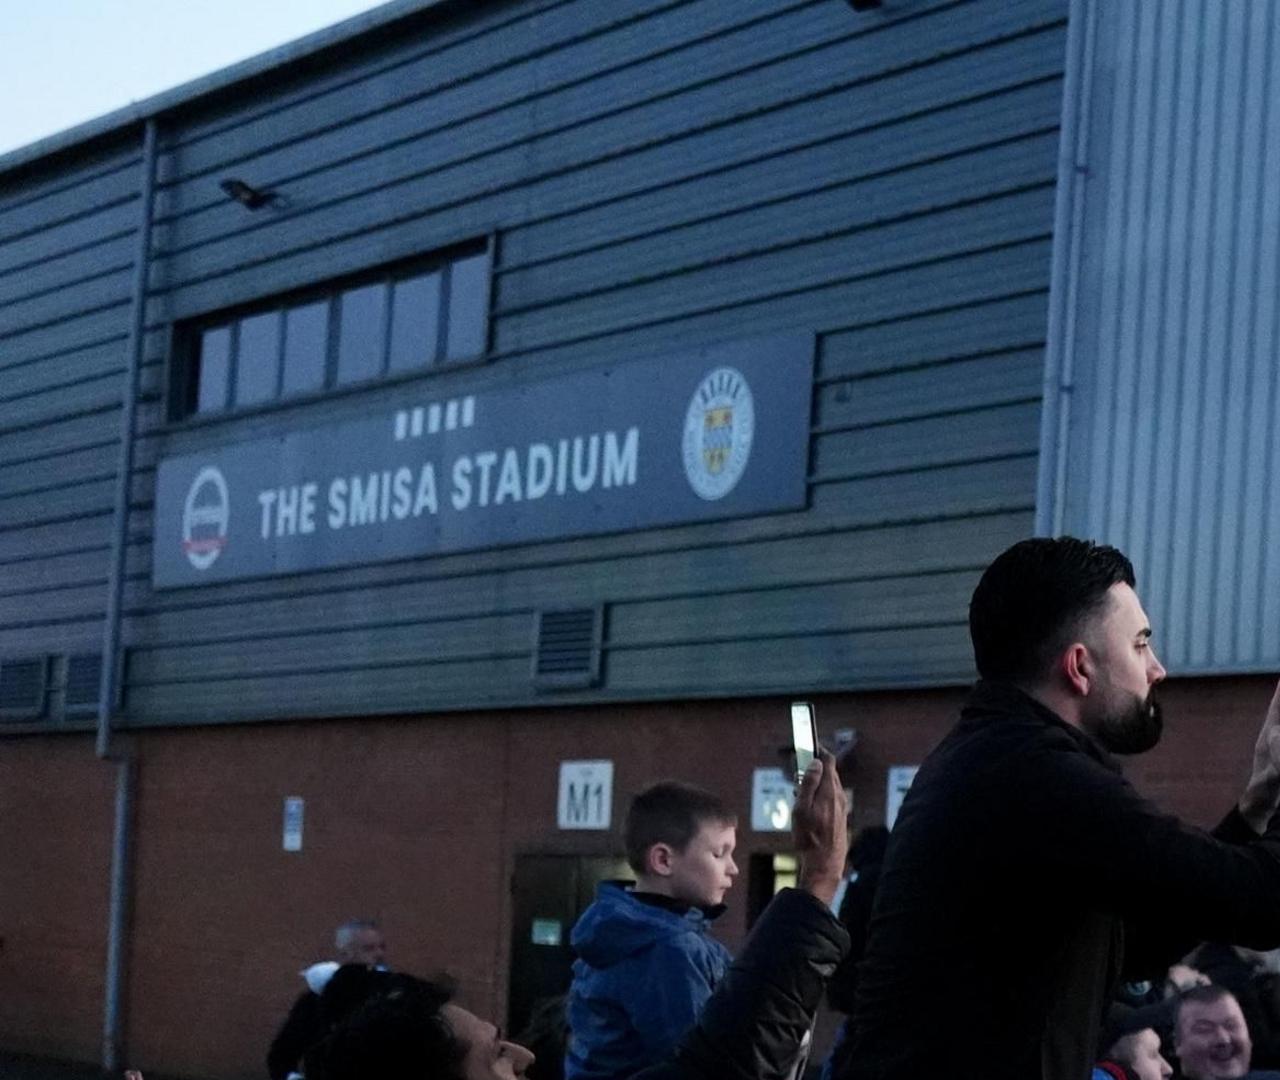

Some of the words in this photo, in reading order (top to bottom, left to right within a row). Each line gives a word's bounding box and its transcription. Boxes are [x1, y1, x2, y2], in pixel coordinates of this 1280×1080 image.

[257, 482, 319, 539] THE
[327, 463, 439, 530] SMISA
[450, 427, 640, 511] STADIUM
[566, 781, 604, 822] M1
